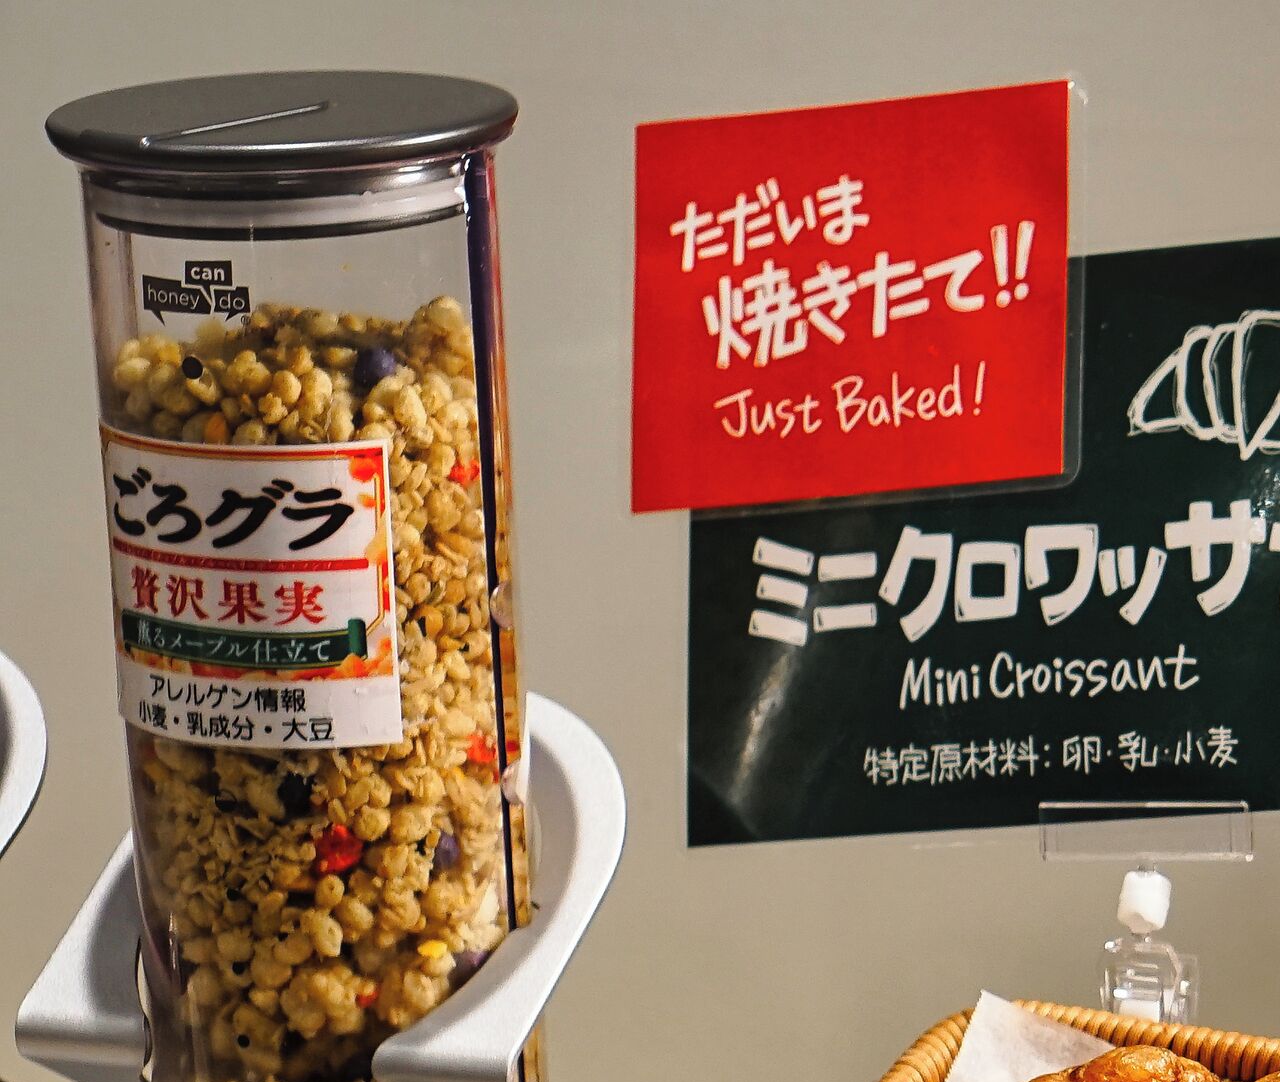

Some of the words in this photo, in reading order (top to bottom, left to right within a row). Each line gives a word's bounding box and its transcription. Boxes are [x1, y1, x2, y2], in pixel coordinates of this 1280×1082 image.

[669, 174, 870, 273] ただいま
[147, 283, 200, 310] honey
[219, 293, 246, 310] do
[190, 266, 225, 281] can
[702, 220, 1036, 370] 焼きたて!!
[713, 388, 823, 439] Just
[831, 360, 986, 434] Baked!
[113, 466, 354, 551] ごろグラ
[131, 564, 327, 626] 贅沢果実
[150, 674, 306, 713] アレルゲン情報
[900, 656, 980, 710] Mini
[989, 643, 1200, 700] Croissant
